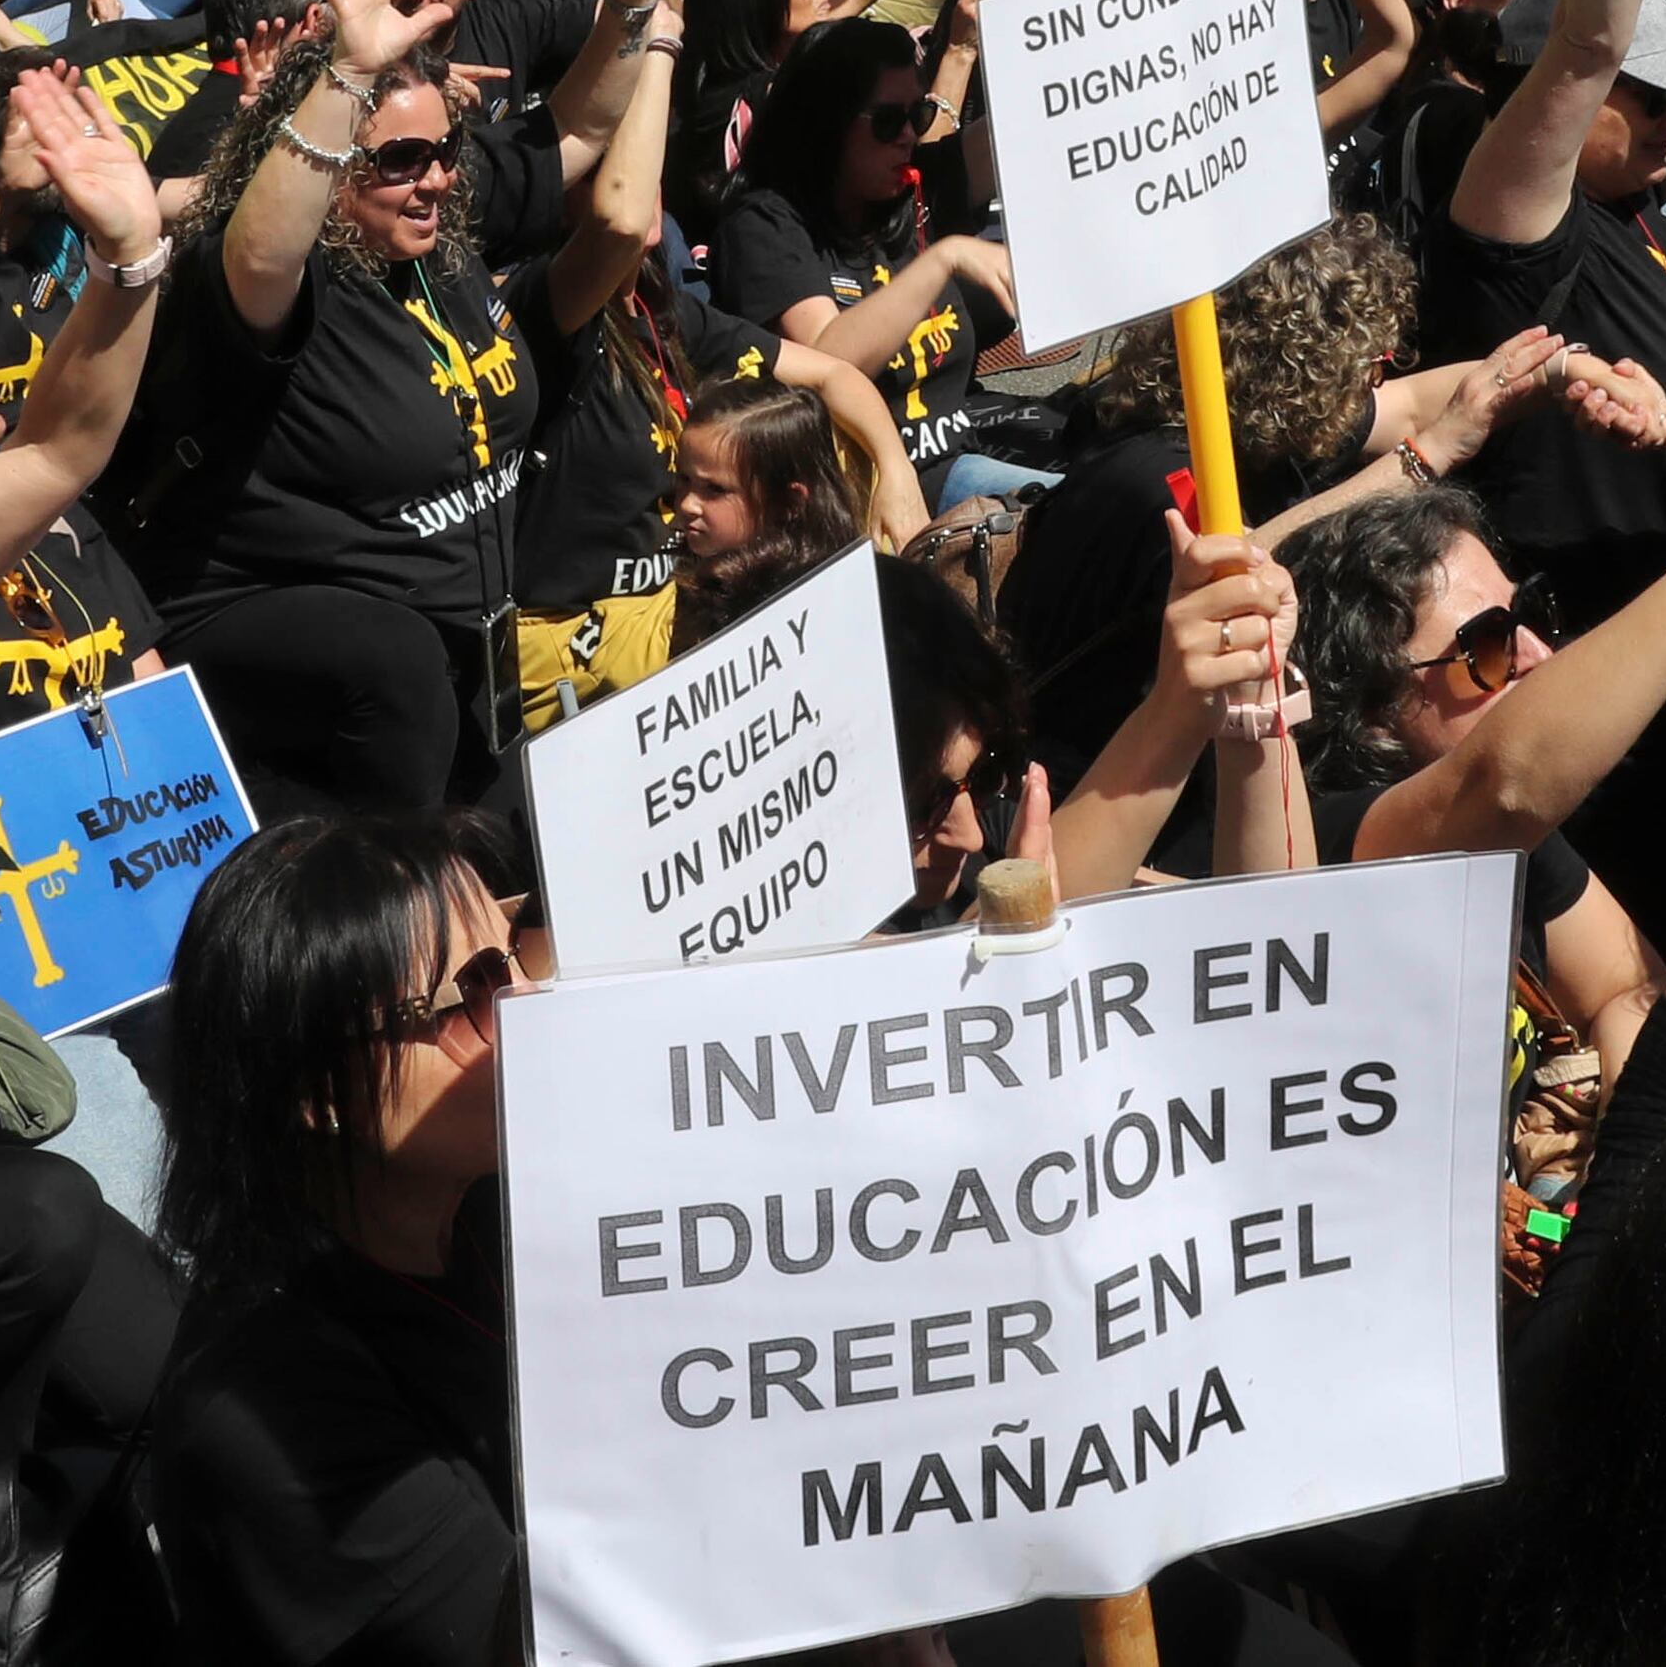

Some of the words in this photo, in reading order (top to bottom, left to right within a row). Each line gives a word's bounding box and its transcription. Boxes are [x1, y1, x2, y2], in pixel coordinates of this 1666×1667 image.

[1023, 4, 1086, 53] SIN
[1042, 44, 1187, 118] DIGNAS,
[1191, 21, 1222, 67] NO
[1067, 79, 1239, 180] EDUCACIÓN
[1244, 61, 1280, 105] DE
[1134, 136, 1249, 216] CALIDAD
[635, 633, 782, 756] FAMILIA
[787, 608, 810, 655] Y
[76, 774, 219, 842] EDUCACIÓN
[643, 689, 822, 829] ESCUELA,
[110, 810, 234, 891] ASTURIANA
[641, 840, 705, 914] UN
[717, 749, 839, 871] MISMO
[679, 839, 829, 966] EQUIPO
[669, 960, 1156, 1132] INVERTIR
[1191, 931, 1331, 1024] EN
[597, 1086, 1227, 1299] EDUCACIÓN
[1268, 1061, 1399, 1152] ES
[659, 1298, 1060, 1430] CREER
[1095, 1237, 1204, 1361] EN
[1232, 1202, 1353, 1296] EL
[800, 1365, 1248, 1548] MAÑANA
